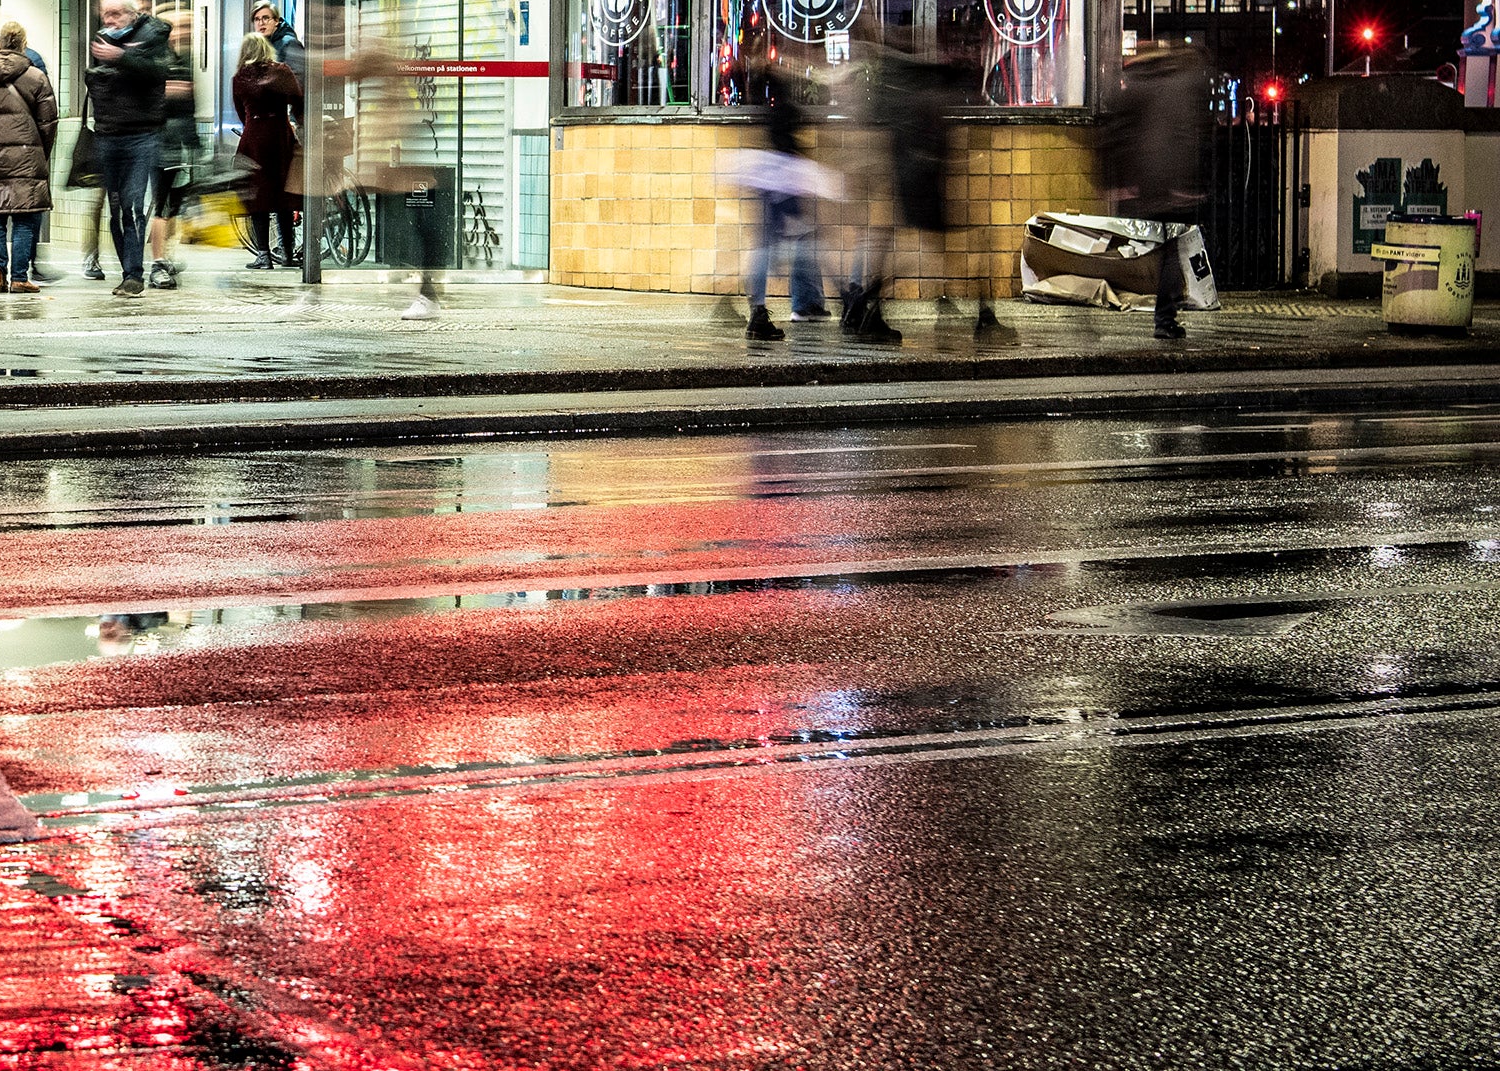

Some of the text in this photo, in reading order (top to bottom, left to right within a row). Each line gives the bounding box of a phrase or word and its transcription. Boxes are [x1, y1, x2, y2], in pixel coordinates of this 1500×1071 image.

[593, 15, 640, 38] COFFEE
[778, 12, 847, 35] COFFEE
[996, 13, 1048, 37] COFFEE
[436, 64, 445, 73] på
[446, 64, 478, 72] stationen
